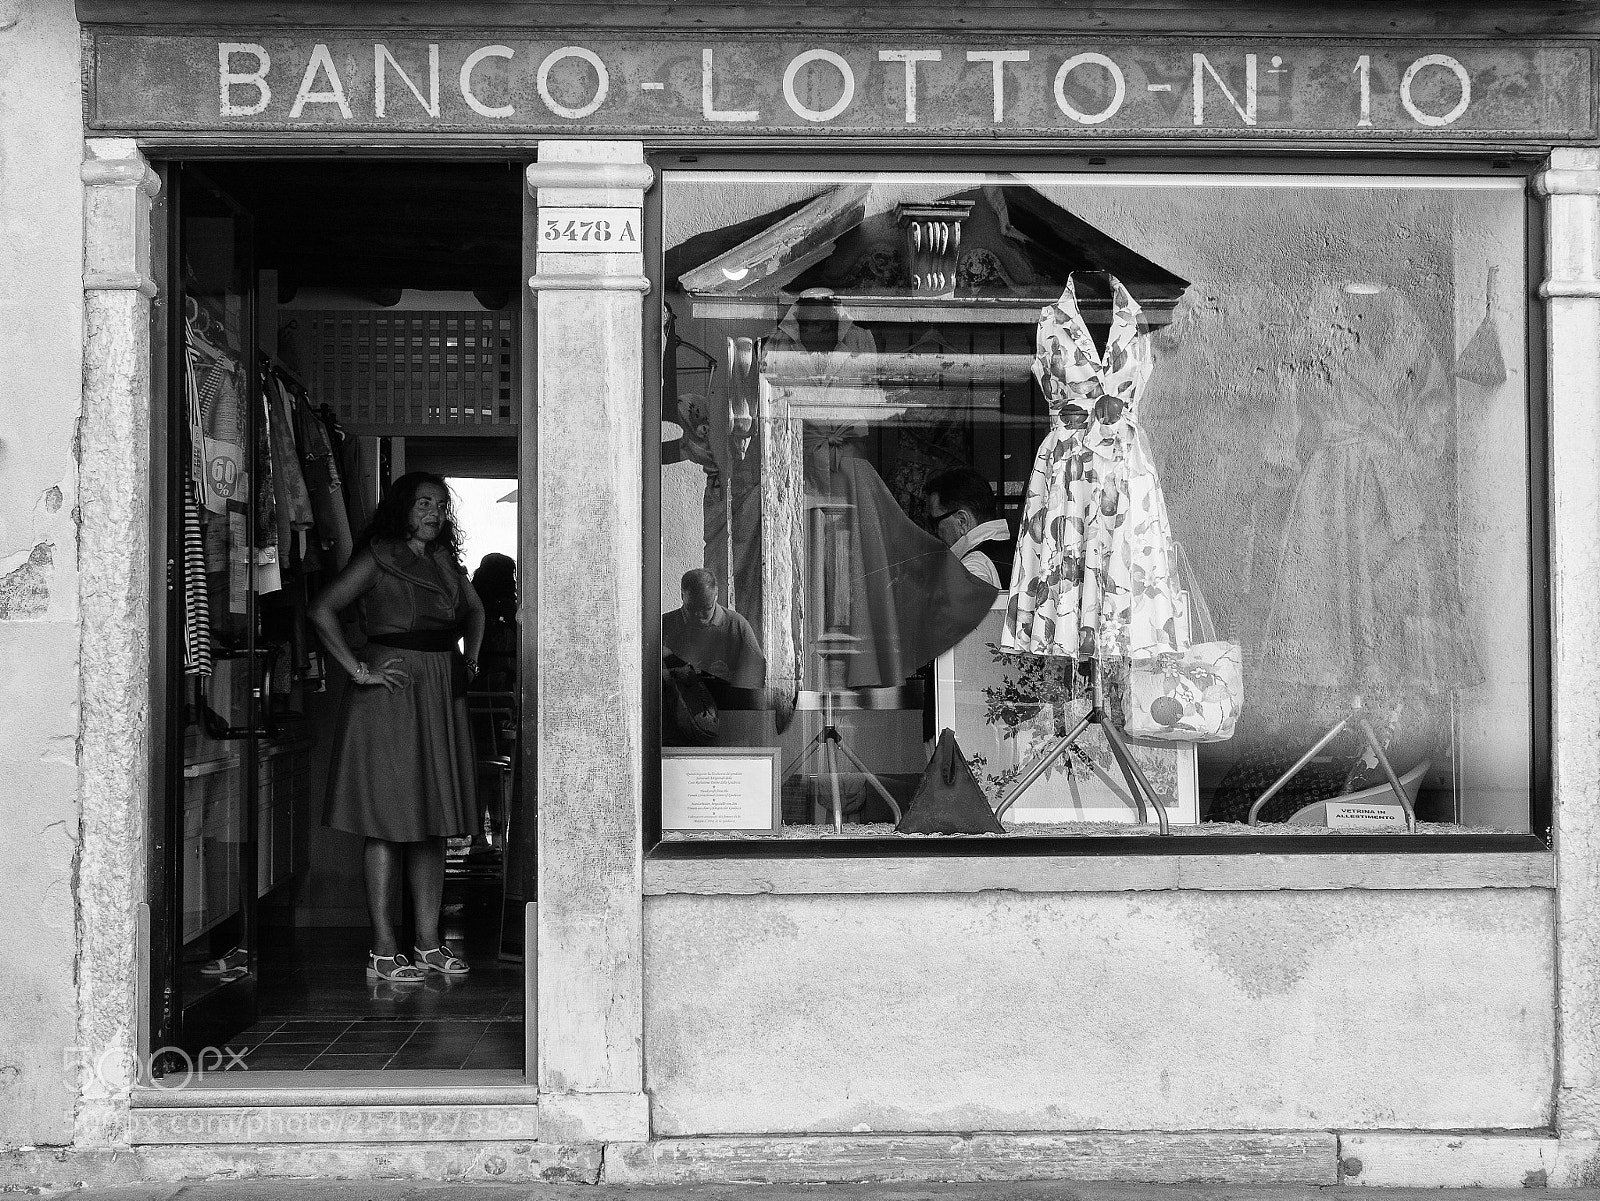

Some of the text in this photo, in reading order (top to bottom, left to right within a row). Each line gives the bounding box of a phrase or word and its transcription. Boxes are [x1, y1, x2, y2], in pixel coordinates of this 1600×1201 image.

[1353, 54, 1471, 126] 10
[544, 220, 637, 242] 3478 A
